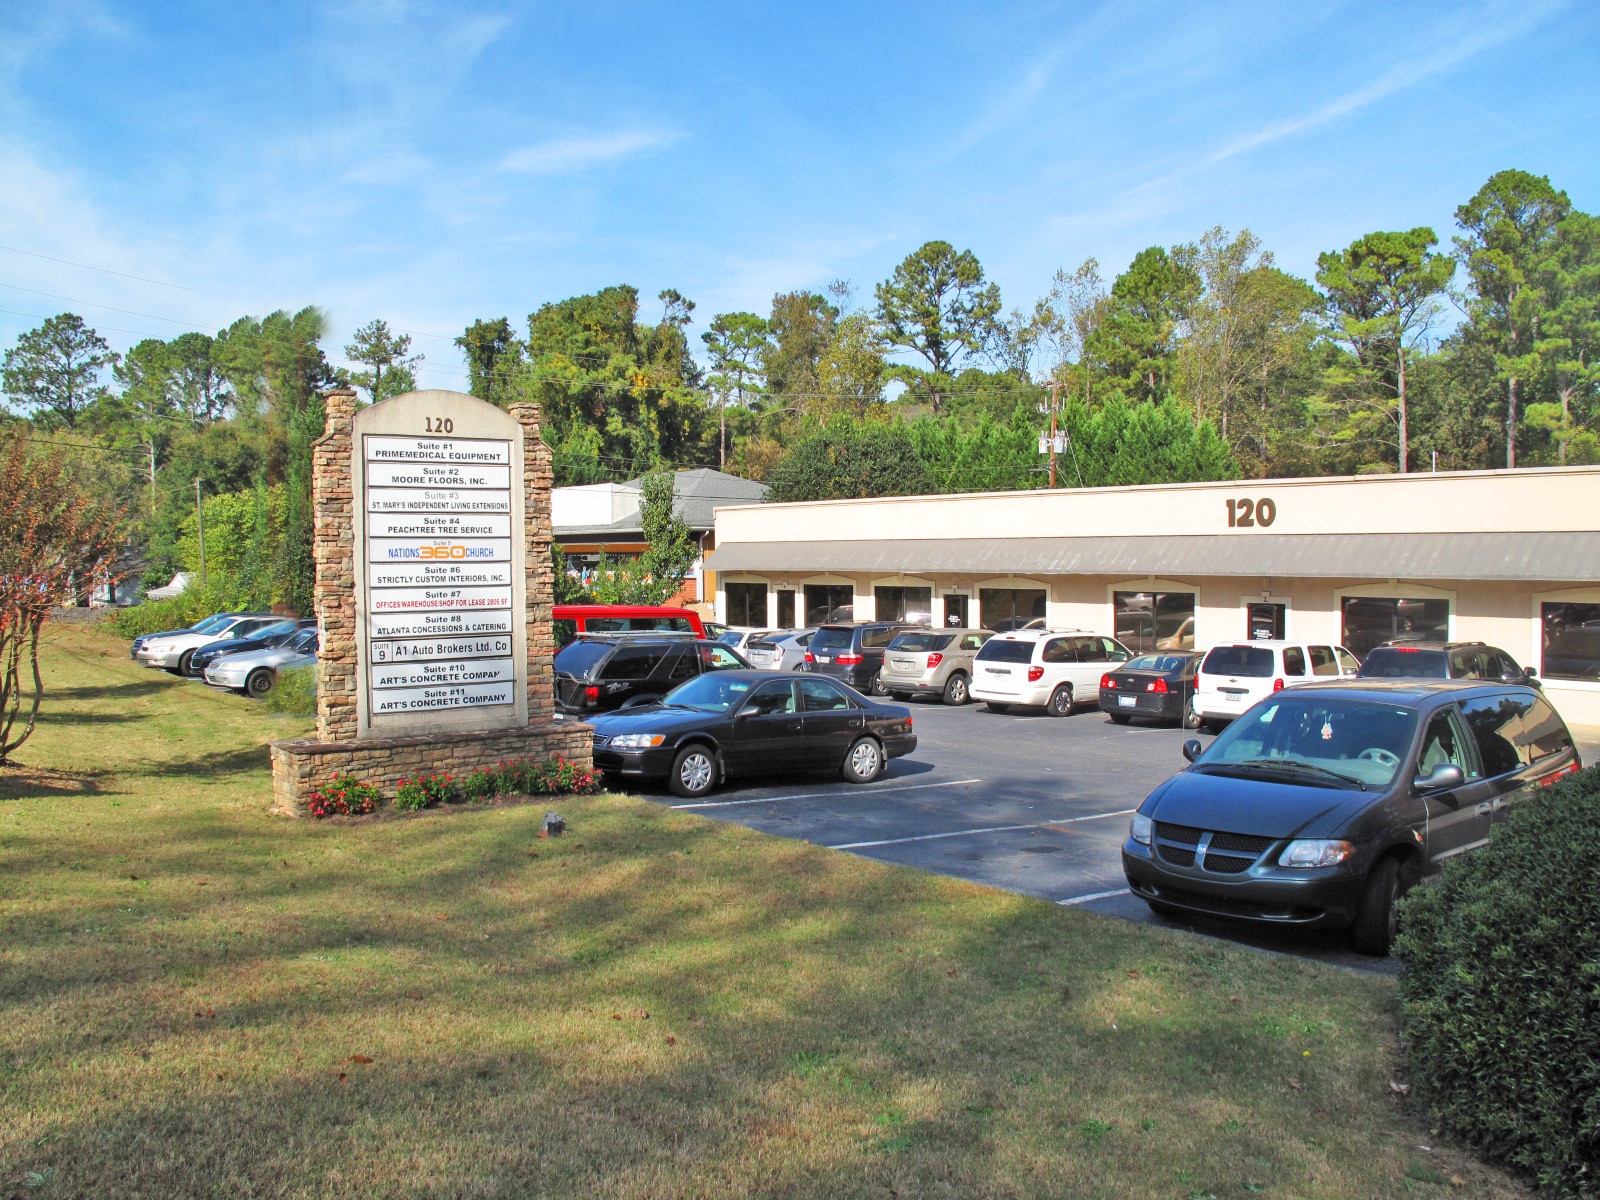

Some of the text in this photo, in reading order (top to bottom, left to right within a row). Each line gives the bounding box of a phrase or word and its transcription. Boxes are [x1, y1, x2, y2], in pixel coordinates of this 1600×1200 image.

[425, 417, 453, 433] 120
[418, 442, 440, 450] Suite
[376, 450, 446, 459] PRIMEMEDICAL
[428, 477, 467, 485] FLOORS,
[1226, 497, 1277, 528] 120
[449, 575, 489, 583] INTERIORS,
[377, 627, 410, 635] ATLANTA
[412, 625, 463, 633] CONCESSIONS
[472, 623, 506, 631] CATERING
[396, 641, 506, 656] A1 Auto Brokers Ltd. Co
[379, 650, 385, 660] 9
[380, 676, 407, 684] ART'S
[411, 674, 459, 683] CONCRETE
[381, 694, 506, 710] ART'S CONCRETE COMPANY
